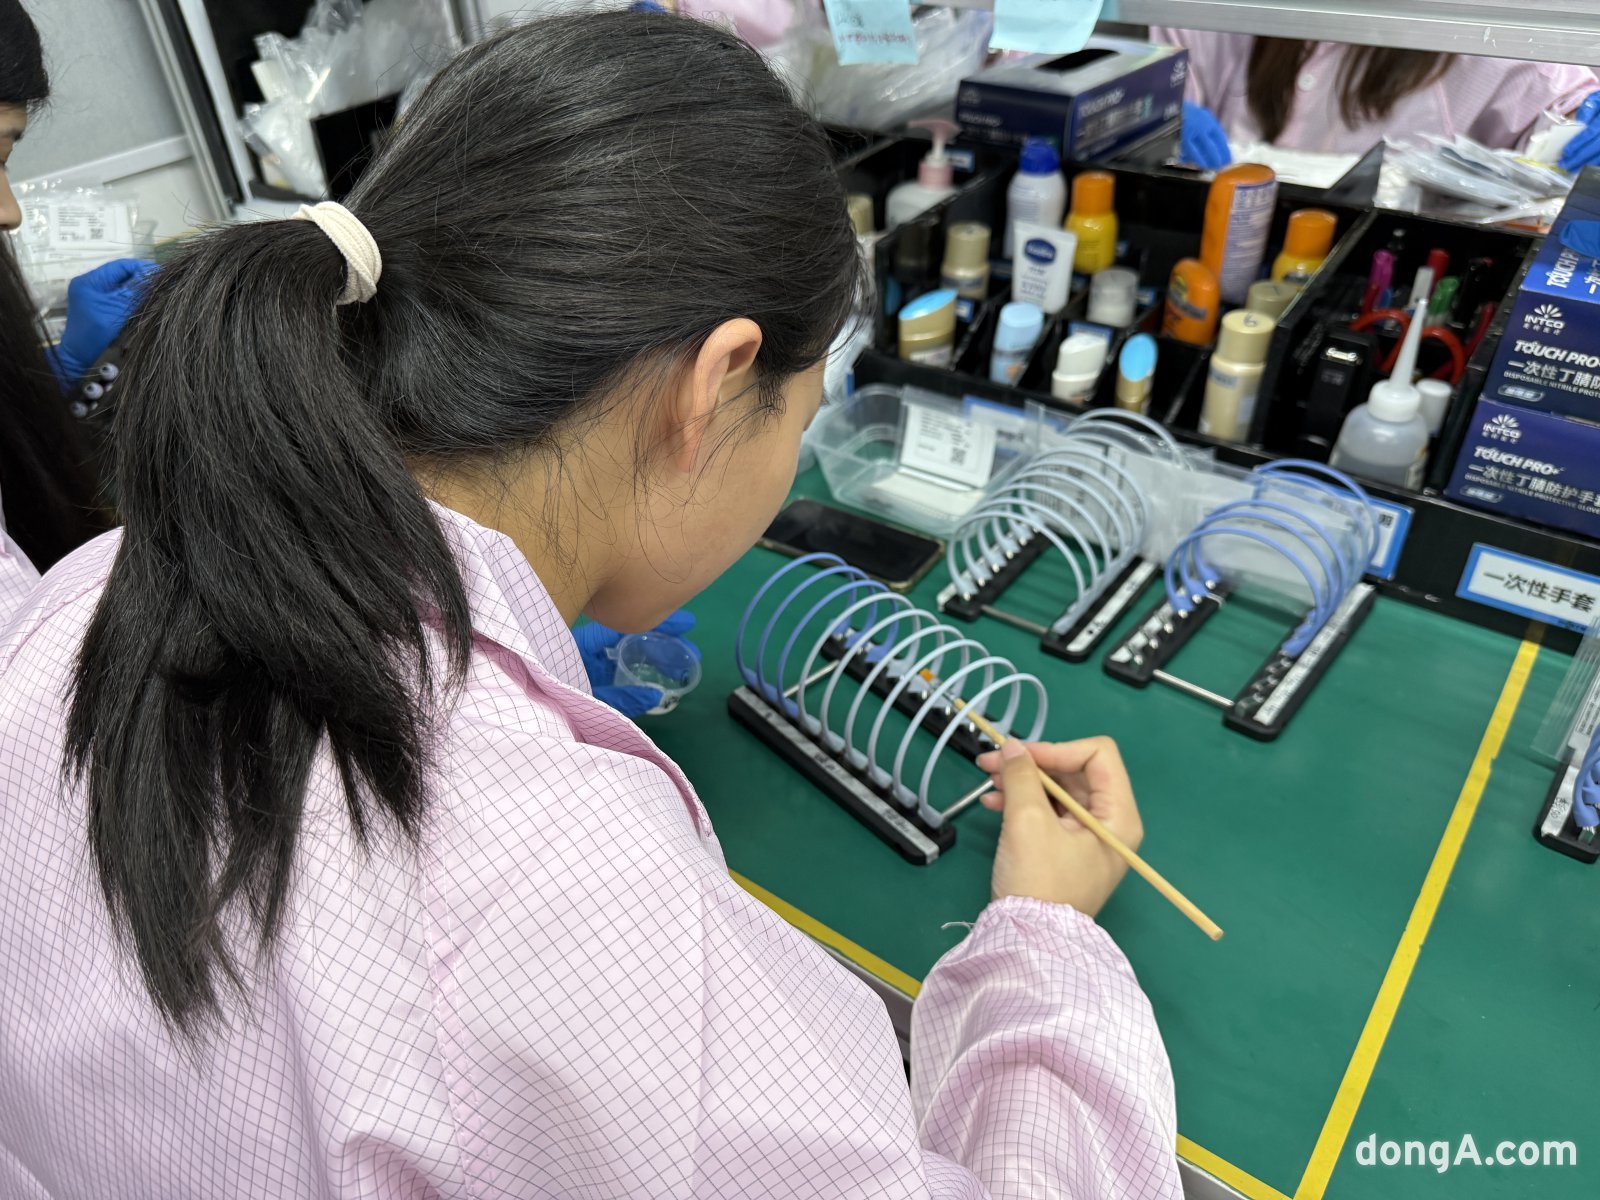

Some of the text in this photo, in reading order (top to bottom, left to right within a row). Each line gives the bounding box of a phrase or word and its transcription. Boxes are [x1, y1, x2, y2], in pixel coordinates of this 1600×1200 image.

[1545, 257, 1577, 289] TOUCH
[1524, 314, 1565, 330] INTCO
[1514, 340, 1568, 362] TOUCH
[1483, 423, 1521, 439] INTCO
[1474, 446, 1524, 468] TOUCH
[1483, 571, 1596, 613] 一次性手套
